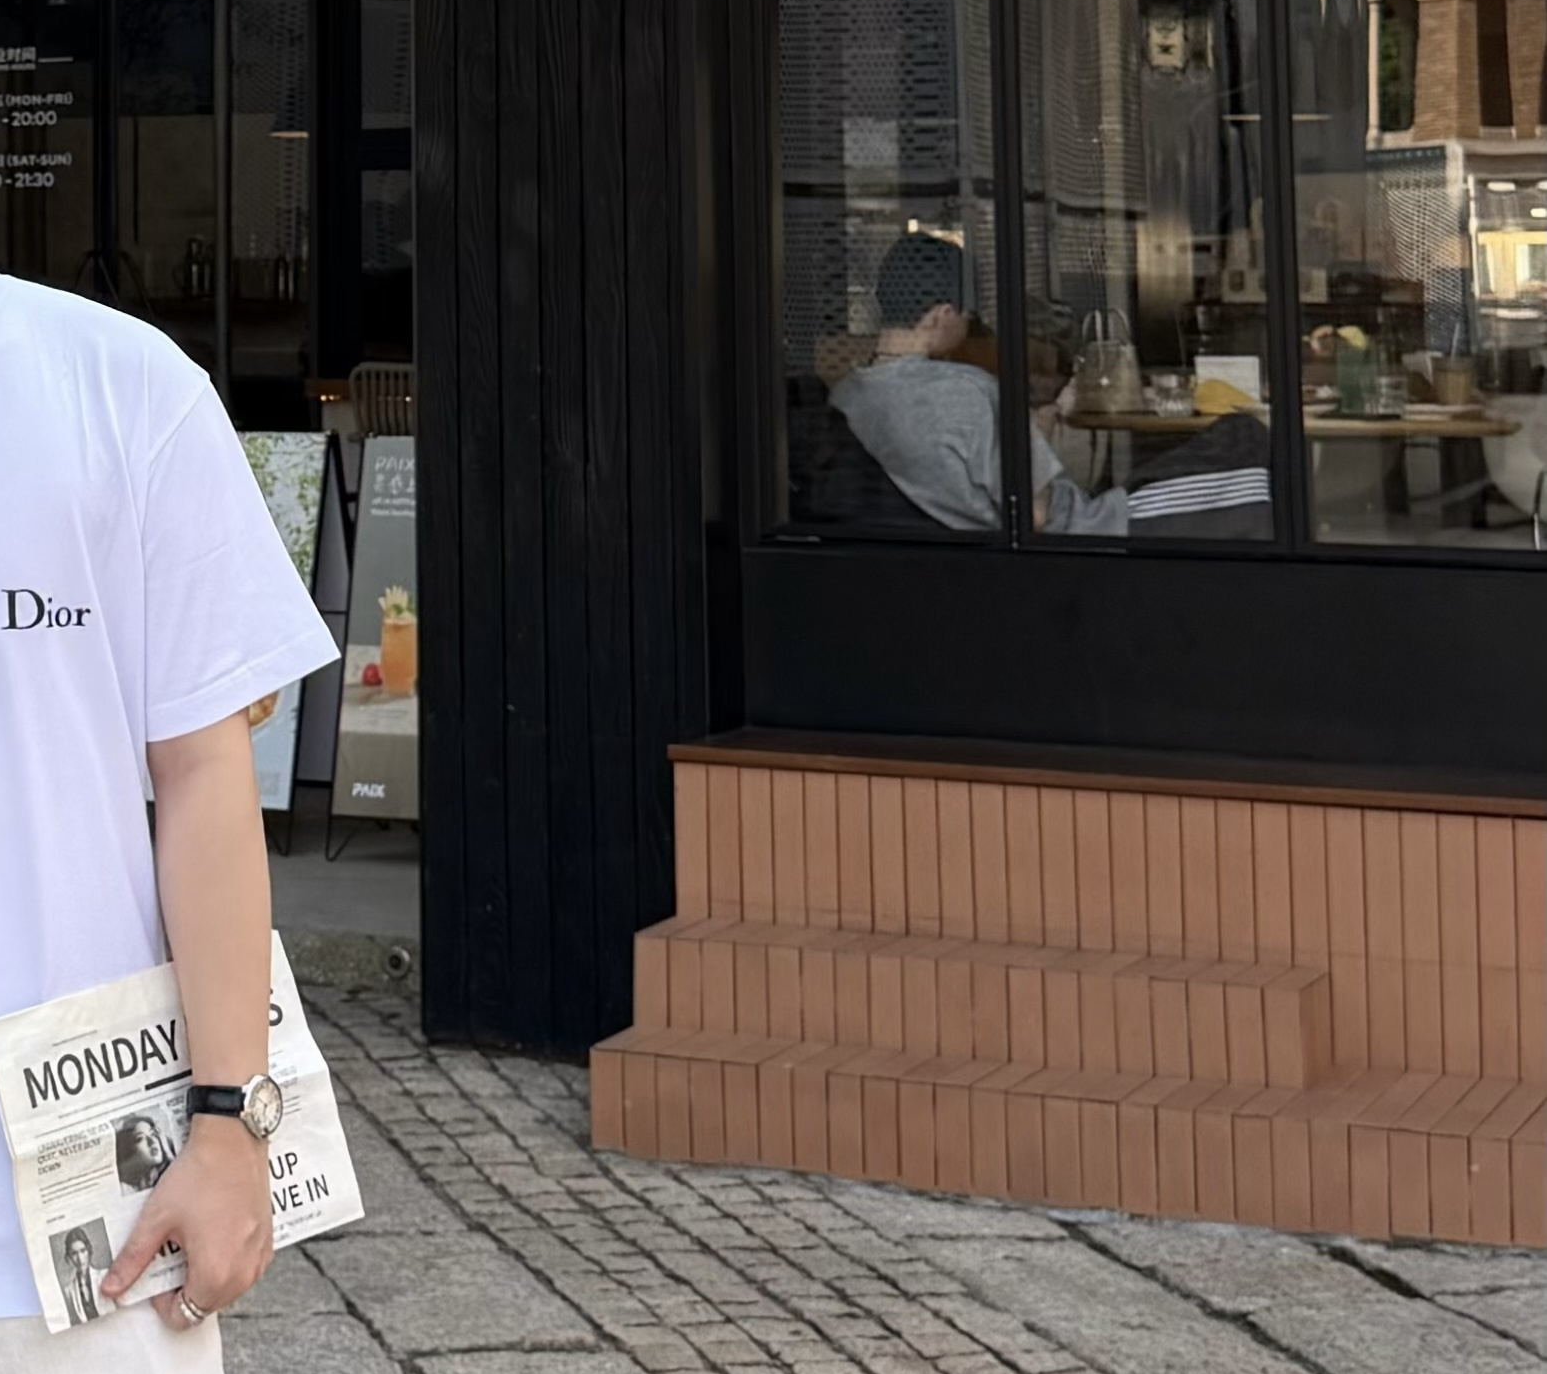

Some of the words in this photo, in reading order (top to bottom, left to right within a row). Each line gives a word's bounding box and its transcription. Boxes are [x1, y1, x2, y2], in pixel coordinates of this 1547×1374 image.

[11, 111, 57, 126] 20:00
[1, 589, 91, 630] Dior
[23, 1019, 179, 1109] MONDAY
[268, 1152, 298, 1180] UP
[305, 1174, 330, 1202] IN
